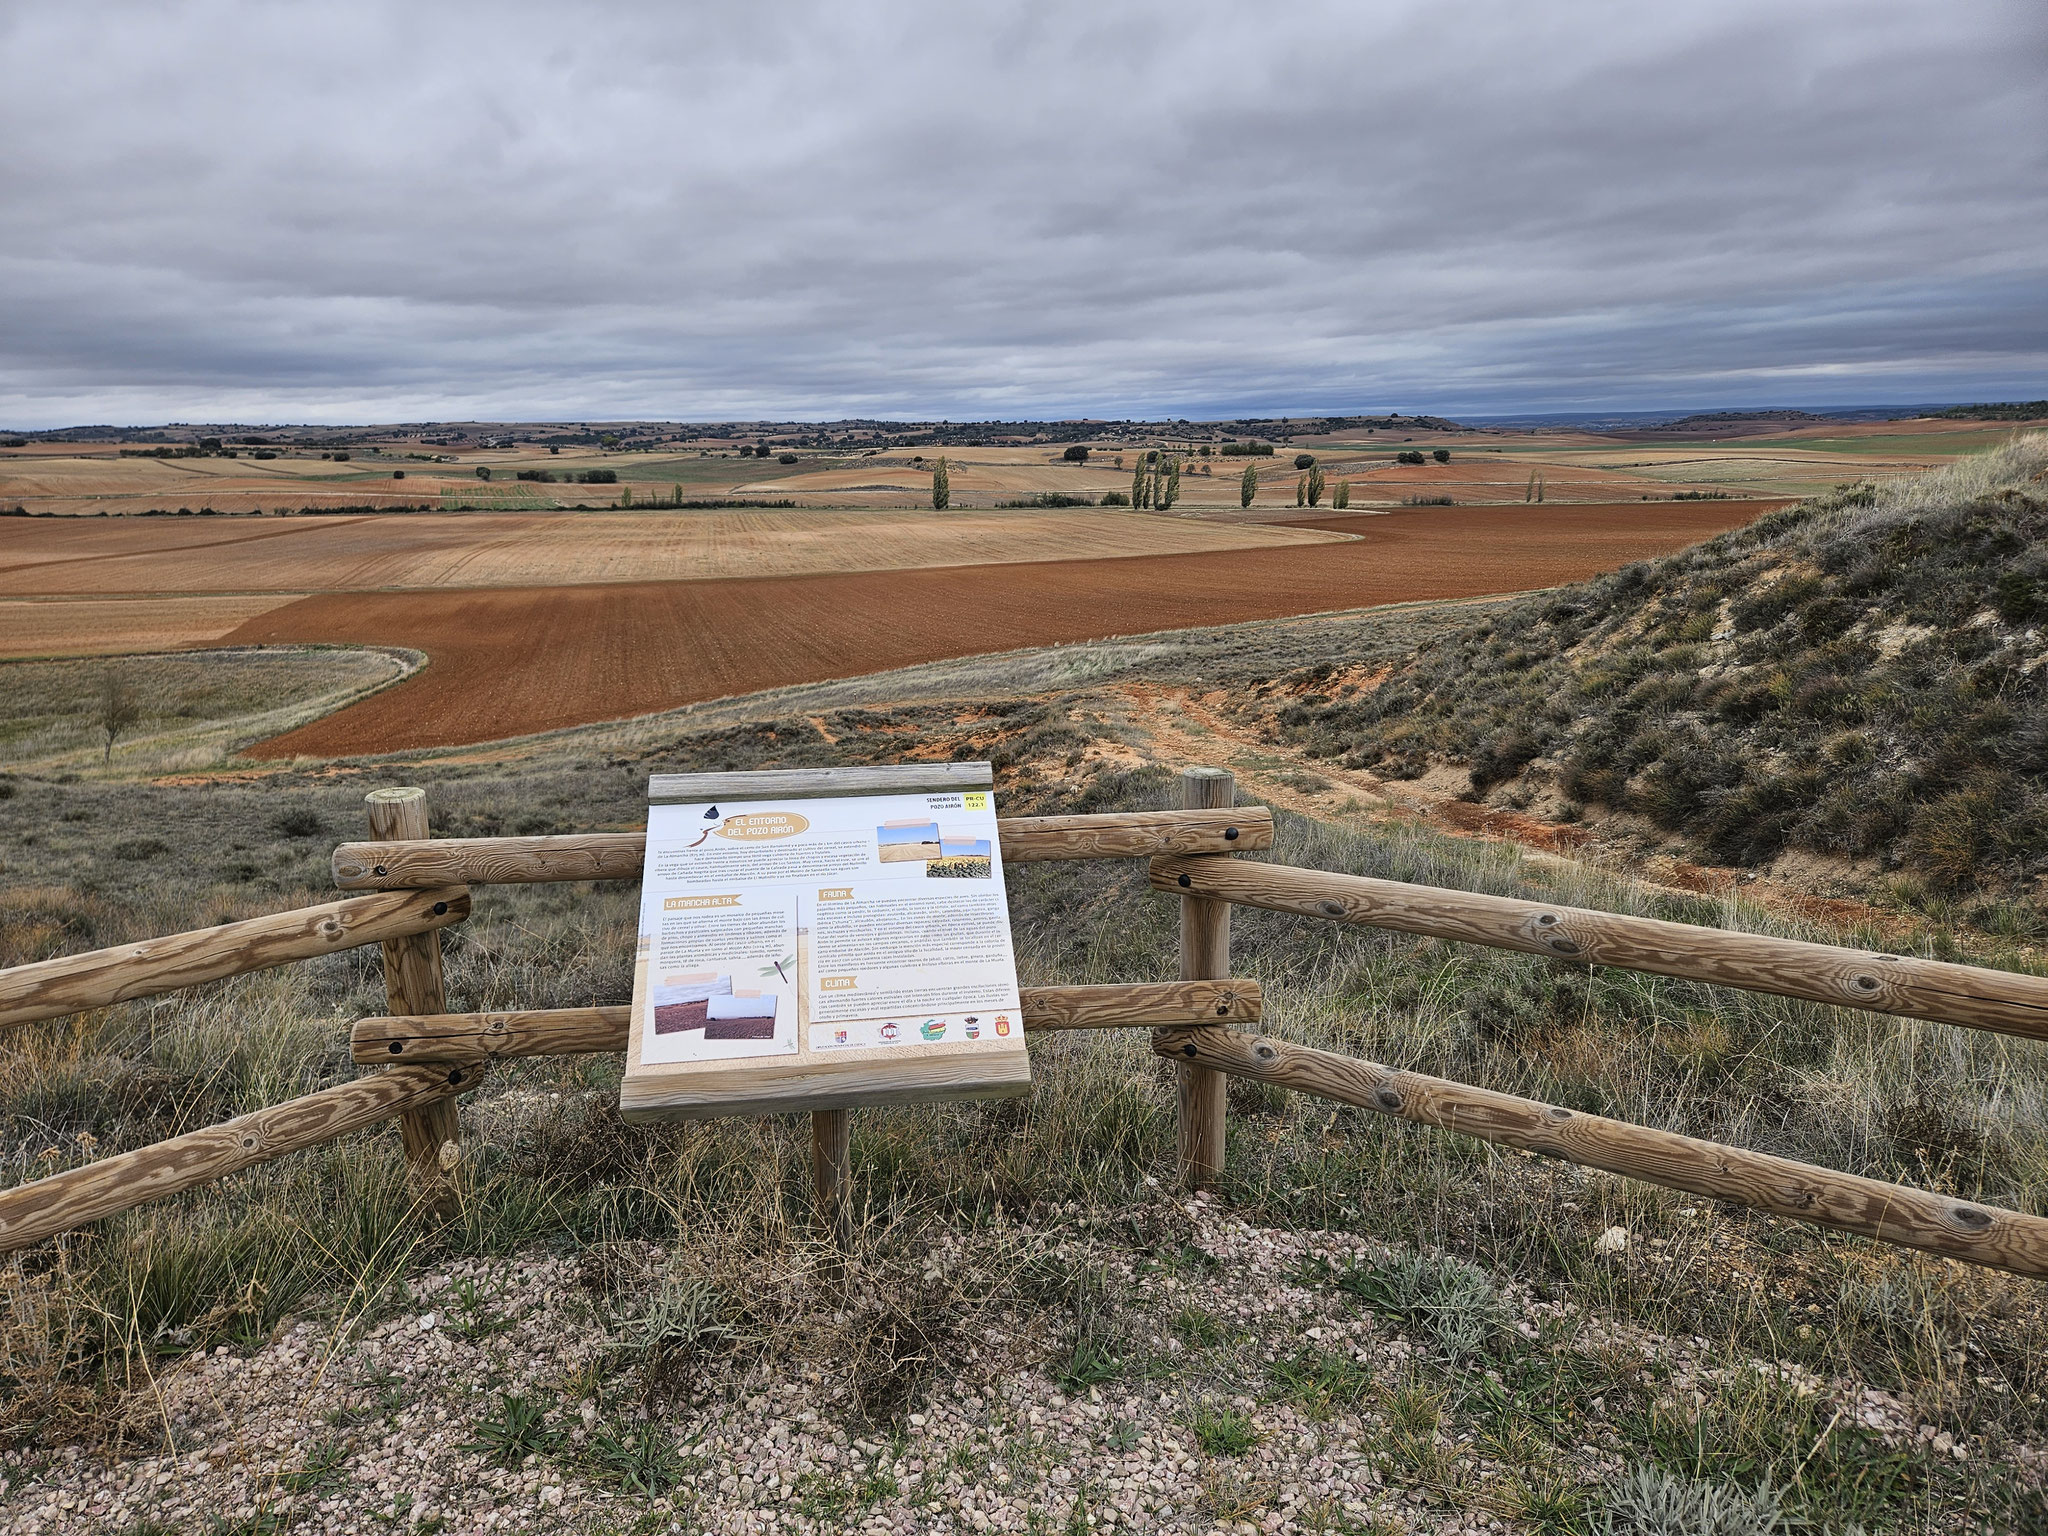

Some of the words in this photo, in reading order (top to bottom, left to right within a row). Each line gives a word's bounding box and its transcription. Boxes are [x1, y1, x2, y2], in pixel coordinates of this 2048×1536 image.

[735, 818, 747, 826] EL
[749, 816, 787, 825] ENTORNO
[727, 828, 744, 836] DEL
[746, 826, 768, 835] POZO
[770, 824, 794, 834] AIRÓN
[823, 890, 847, 898] FAUNA
[665, 900, 677, 908] LA
[678, 898, 710, 907] MANCHA
[711, 897, 732, 905] ALTA
[825, 979, 850, 988] CLIMA
